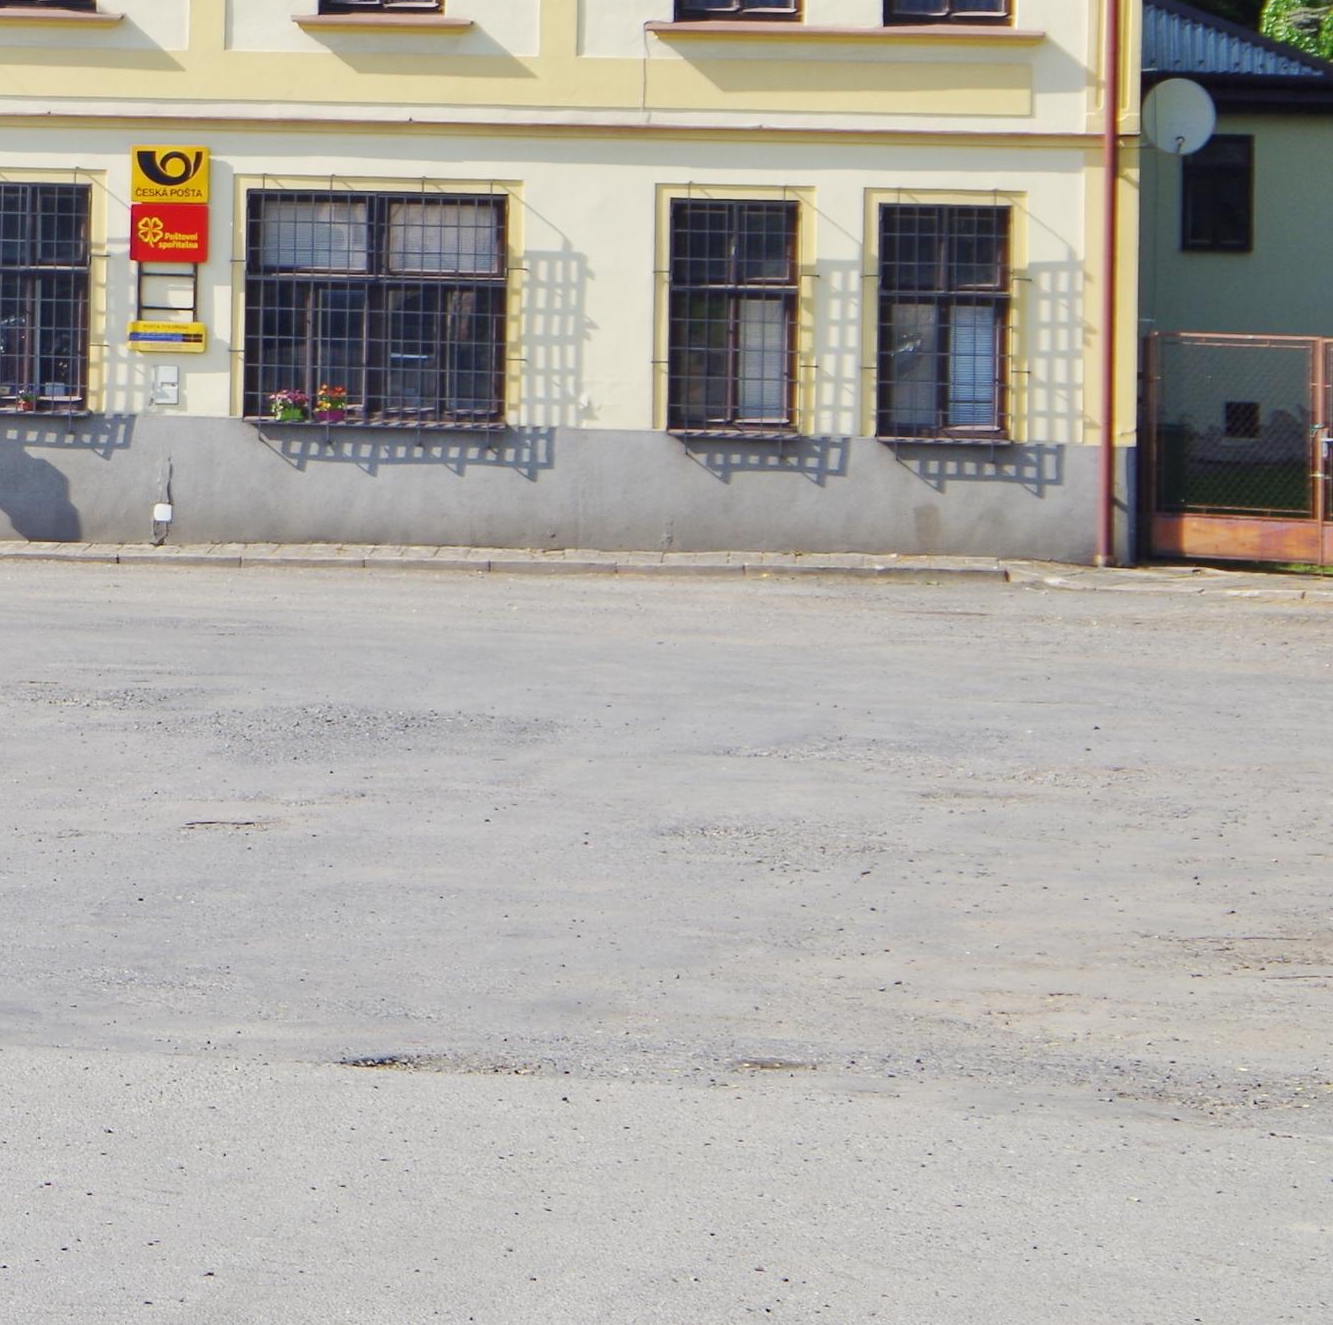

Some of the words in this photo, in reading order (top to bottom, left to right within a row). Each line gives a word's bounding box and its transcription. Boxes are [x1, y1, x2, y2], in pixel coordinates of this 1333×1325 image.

[135, 187, 168, 197] ČESKÁ
[170, 187, 202, 197] POŠTA
[164, 231, 198, 241] Poštovní
[158, 240, 199, 250] spořitelna
